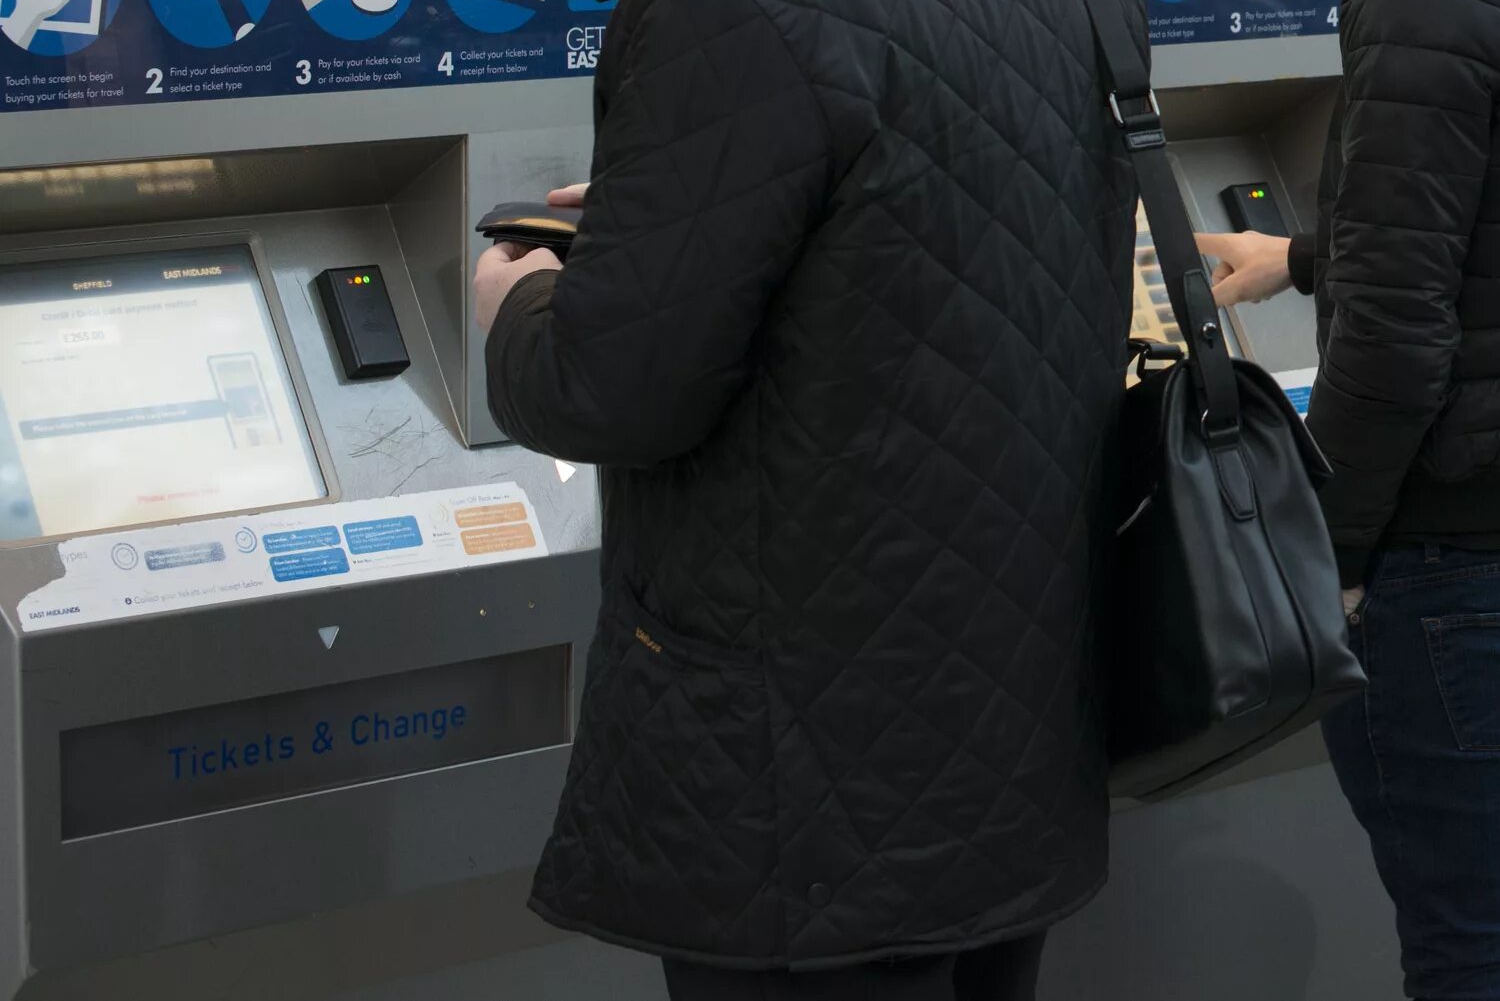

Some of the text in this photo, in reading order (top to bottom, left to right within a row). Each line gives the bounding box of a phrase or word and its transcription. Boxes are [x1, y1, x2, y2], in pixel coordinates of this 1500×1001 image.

[1172, 15, 1202, 24] destination
[1203, 14, 1214, 22] and
[1230, 12, 1241, 34] 3
[1326, 6, 1339, 27] 4
[567, 27, 606, 50] GET
[1167, 29, 1194, 38] ticket type
[460, 47, 543, 61] Collect your tickets and
[170, 62, 272, 77] Find your destination and
[318, 54, 420, 70] Pay for your tickets via card
[437, 51, 454, 76] 4
[460, 62, 527, 76] receipt from below
[5, 71, 113, 86] Touch the screen to begin
[296, 59, 312, 85] 3
[318, 70, 401, 84] or if available by cash
[145, 68, 163, 94] 2
[170, 82, 193, 93] select
[203, 81, 224, 91] ticket
[225, 81, 242, 91] type
[5, 87, 124, 104] buying your tickets for travel
[163, 269, 181, 279] EAST
[182, 266, 222, 277] MIDLANDS
[73, 280, 112, 290] SHEFFIELD
[29, 606, 80, 619] EAST MIDLANDS
[168, 704, 466, 780] Tickets & Change
